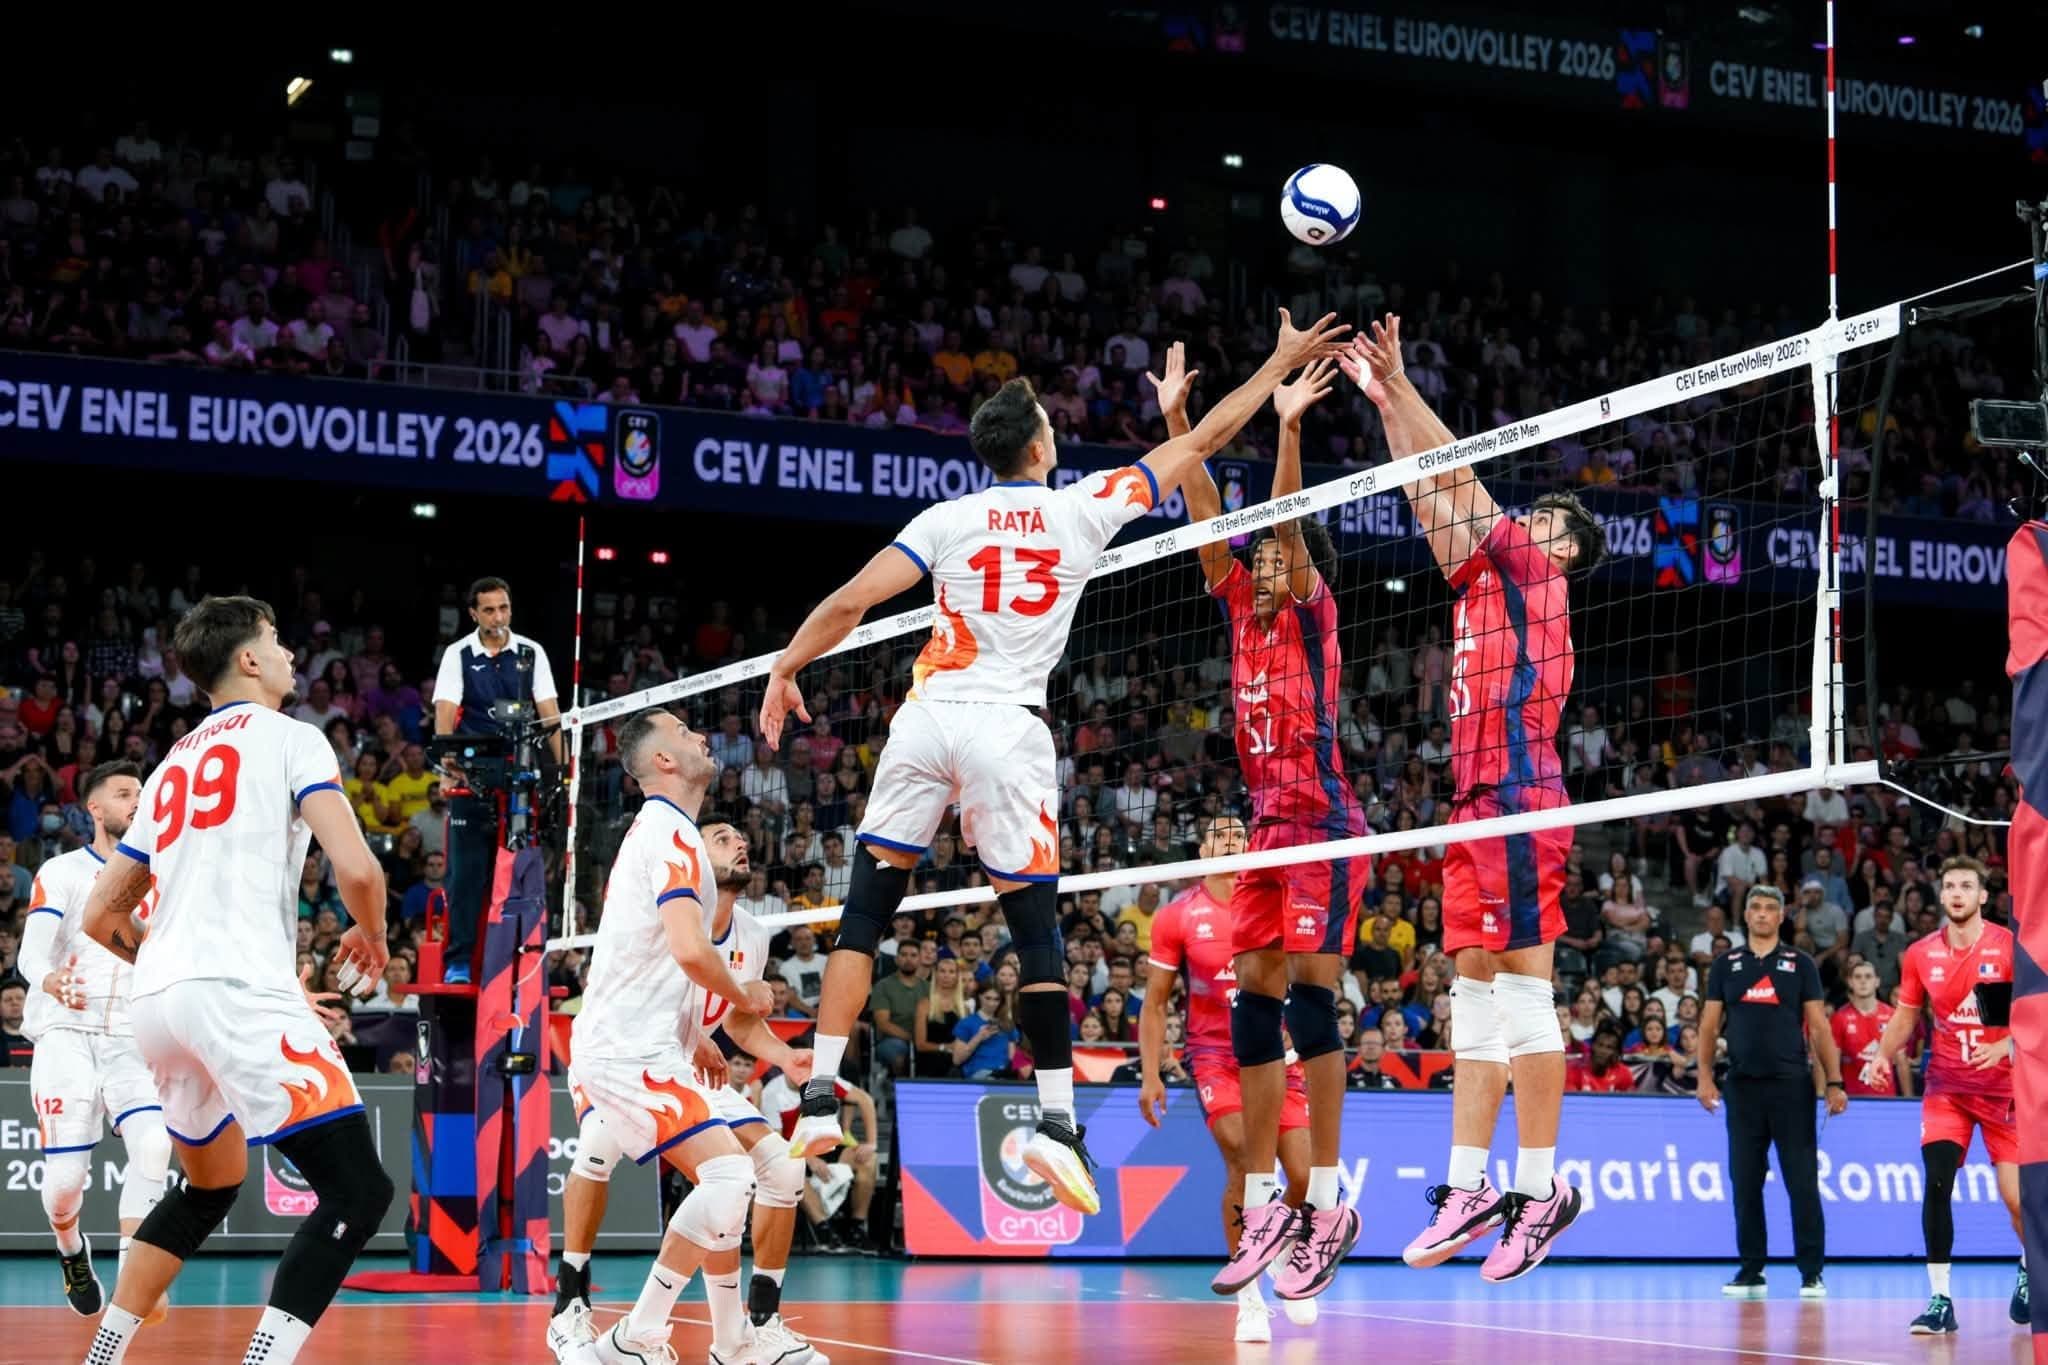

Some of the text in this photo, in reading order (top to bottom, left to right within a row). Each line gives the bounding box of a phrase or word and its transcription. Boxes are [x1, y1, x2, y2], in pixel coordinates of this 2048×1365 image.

[1269, 4, 1615, 80] CEV ENEL EUROVOLLEY 2026
[1709, 61, 2023, 135] CEV ENEL UROVOLLEY 2026
[1859, 318, 1881, 335] CEV
[1676, 372, 1697, 392] CEV
[1698, 363, 1720, 386] Enel
[1721, 352, 1775, 380] EuroVolley
[0, 380, 544, 468] CEV ENEL EUROVOLLEY 2026
[1418, 423, 1541, 470] CEV Enel EuroVolley 2026 Men
[694, 437, 769, 485] CEV
[778, 444, 862, 493] ENEL
[1240, 505, 1276, 529] EuroVolley
[1294, 495, 1311, 510] Men
[969, 546, 1061, 617] 13
[153, 744, 240, 853] 99
[1954, 1007, 1981, 1017] MAI
[44, 1098, 63, 1115] 12
[1001, 1213, 1067, 1238] enel
